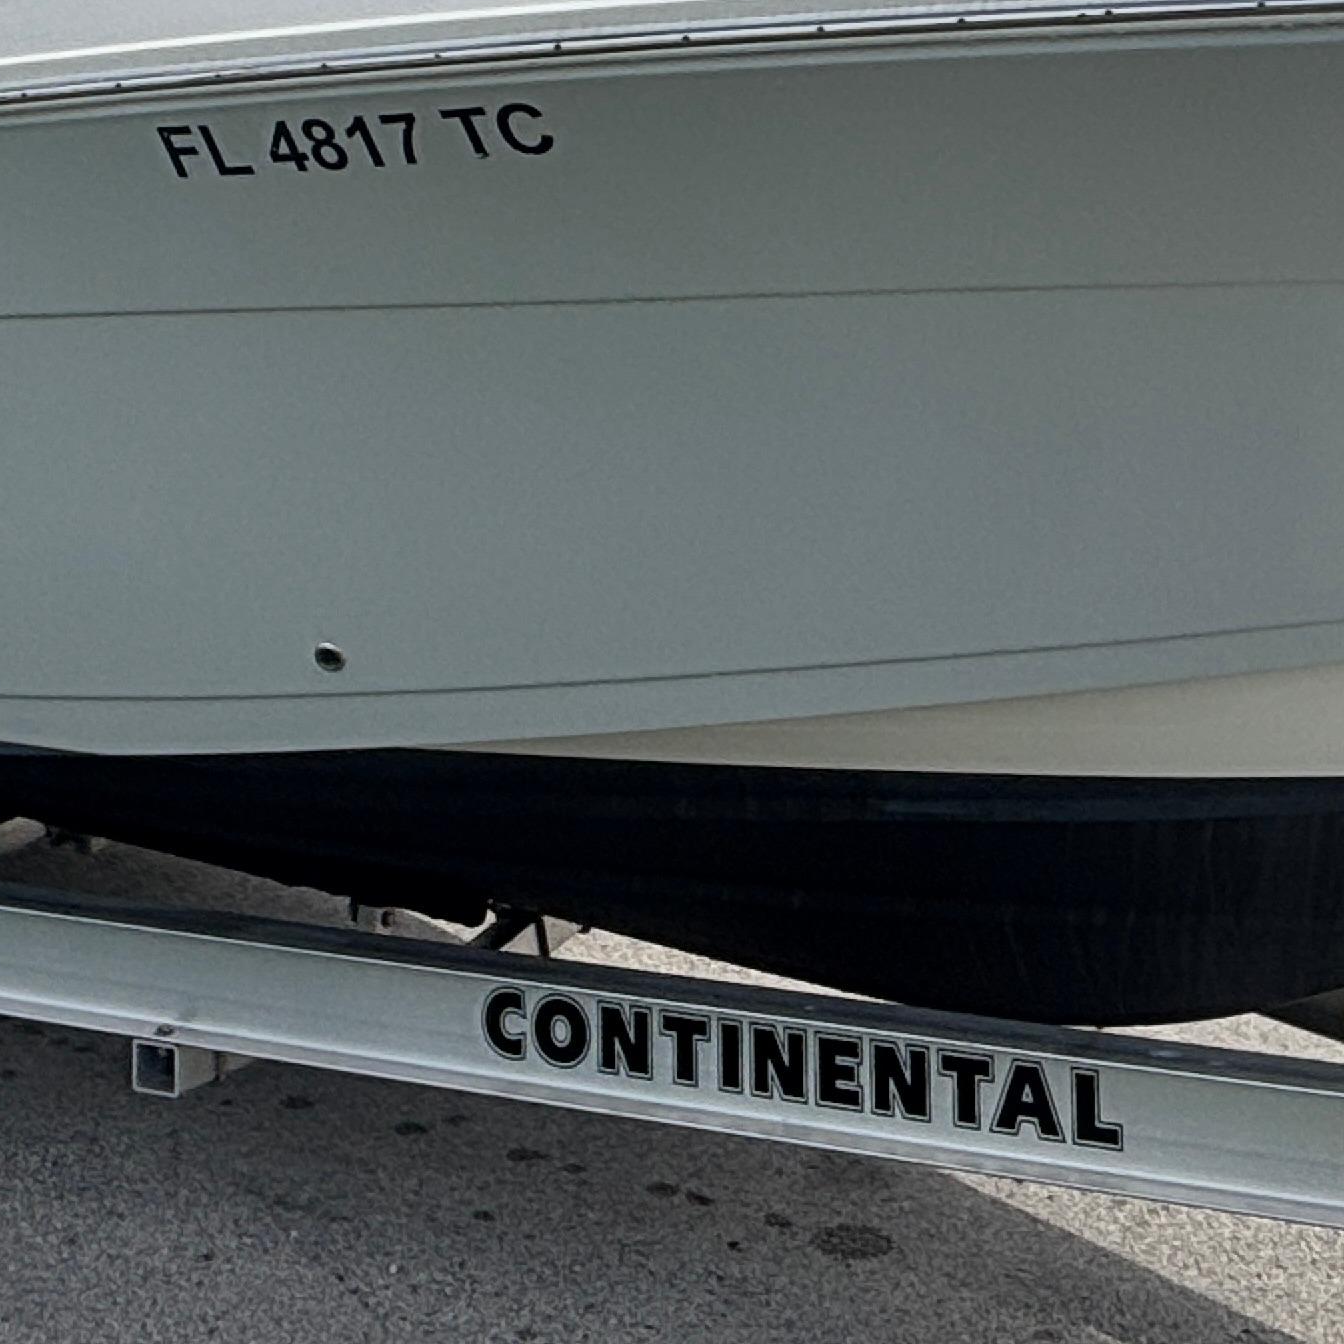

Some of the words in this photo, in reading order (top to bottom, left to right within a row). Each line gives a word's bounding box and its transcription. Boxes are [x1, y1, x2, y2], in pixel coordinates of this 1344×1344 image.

[157, 125, 255, 178] FL
[269, 112, 418, 172] 4817
[439, 102, 554, 159] TC
[482, 986, 1124, 1151] CONTINENTAL
